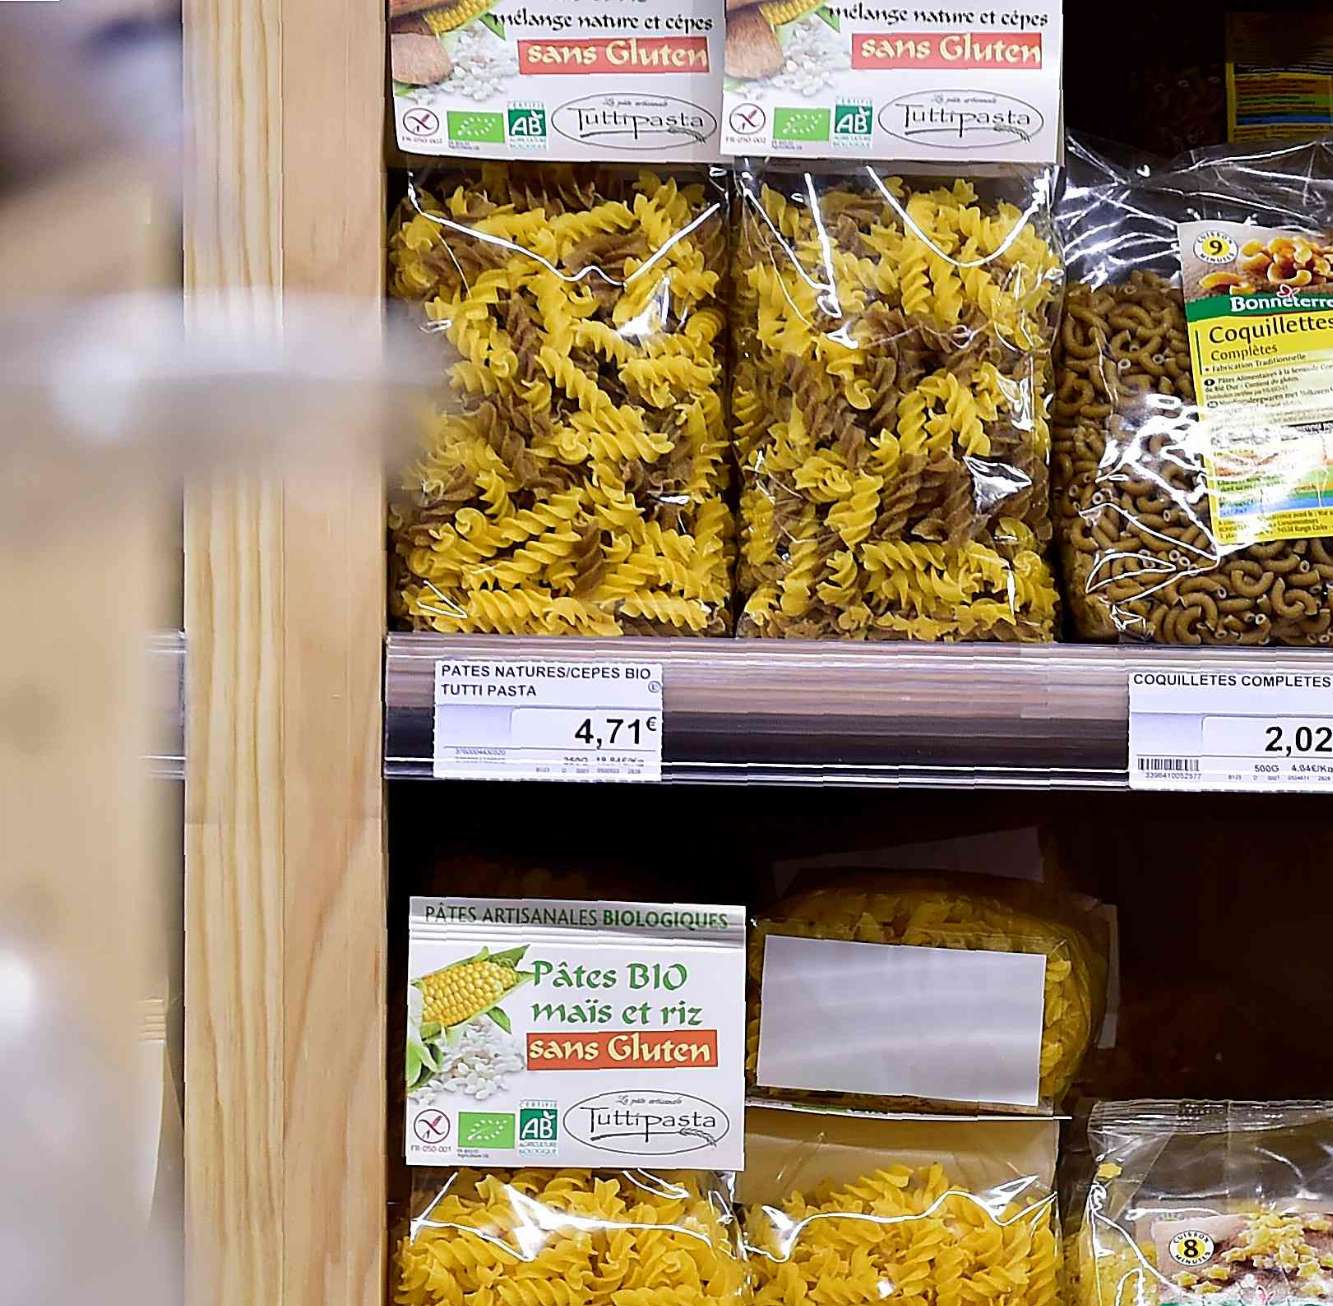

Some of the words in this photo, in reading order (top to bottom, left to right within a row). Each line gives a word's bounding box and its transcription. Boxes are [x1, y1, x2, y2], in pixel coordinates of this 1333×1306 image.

[493, 11, 572, 30] mélange
[577, 15, 639, 29] nature
[644, 17, 659, 30] et
[527, 44, 596, 64] sans
[606, 39, 707, 67] Gluten
[567, 107, 705, 139] Tuttipasta
[1209, 240, 1222, 255] 9
[1211, 344, 1278, 362] Complètes
[442, 665, 490, 678] PATES
[495, 665, 621, 680] NATURES/CEPES
[626, 667, 651, 680] BIO
[1133, 674, 1236, 687] COQUILLETES
[1241, 675, 1331, 687] COMPLETES
[441, 683, 483, 696] TUTTI
[487, 684, 537, 697] PASTA
[425, 904, 477, 922] PÂTES
[483, 907, 597, 926] ARTISANALES
[603, 911, 728, 930] BIOLOGIQUES
[531, 960, 617, 989] Pâtes
[626, 962, 688, 991] BIO
[531, 1000, 612, 1024] maïs
[621, 1005, 650, 1024] et
[661, 1001, 703, 1026] riz
[529, 1039, 598, 1060] sans
[607, 1032, 710, 1062] Gluten
[1184, 1239, 1198, 1258] 8
